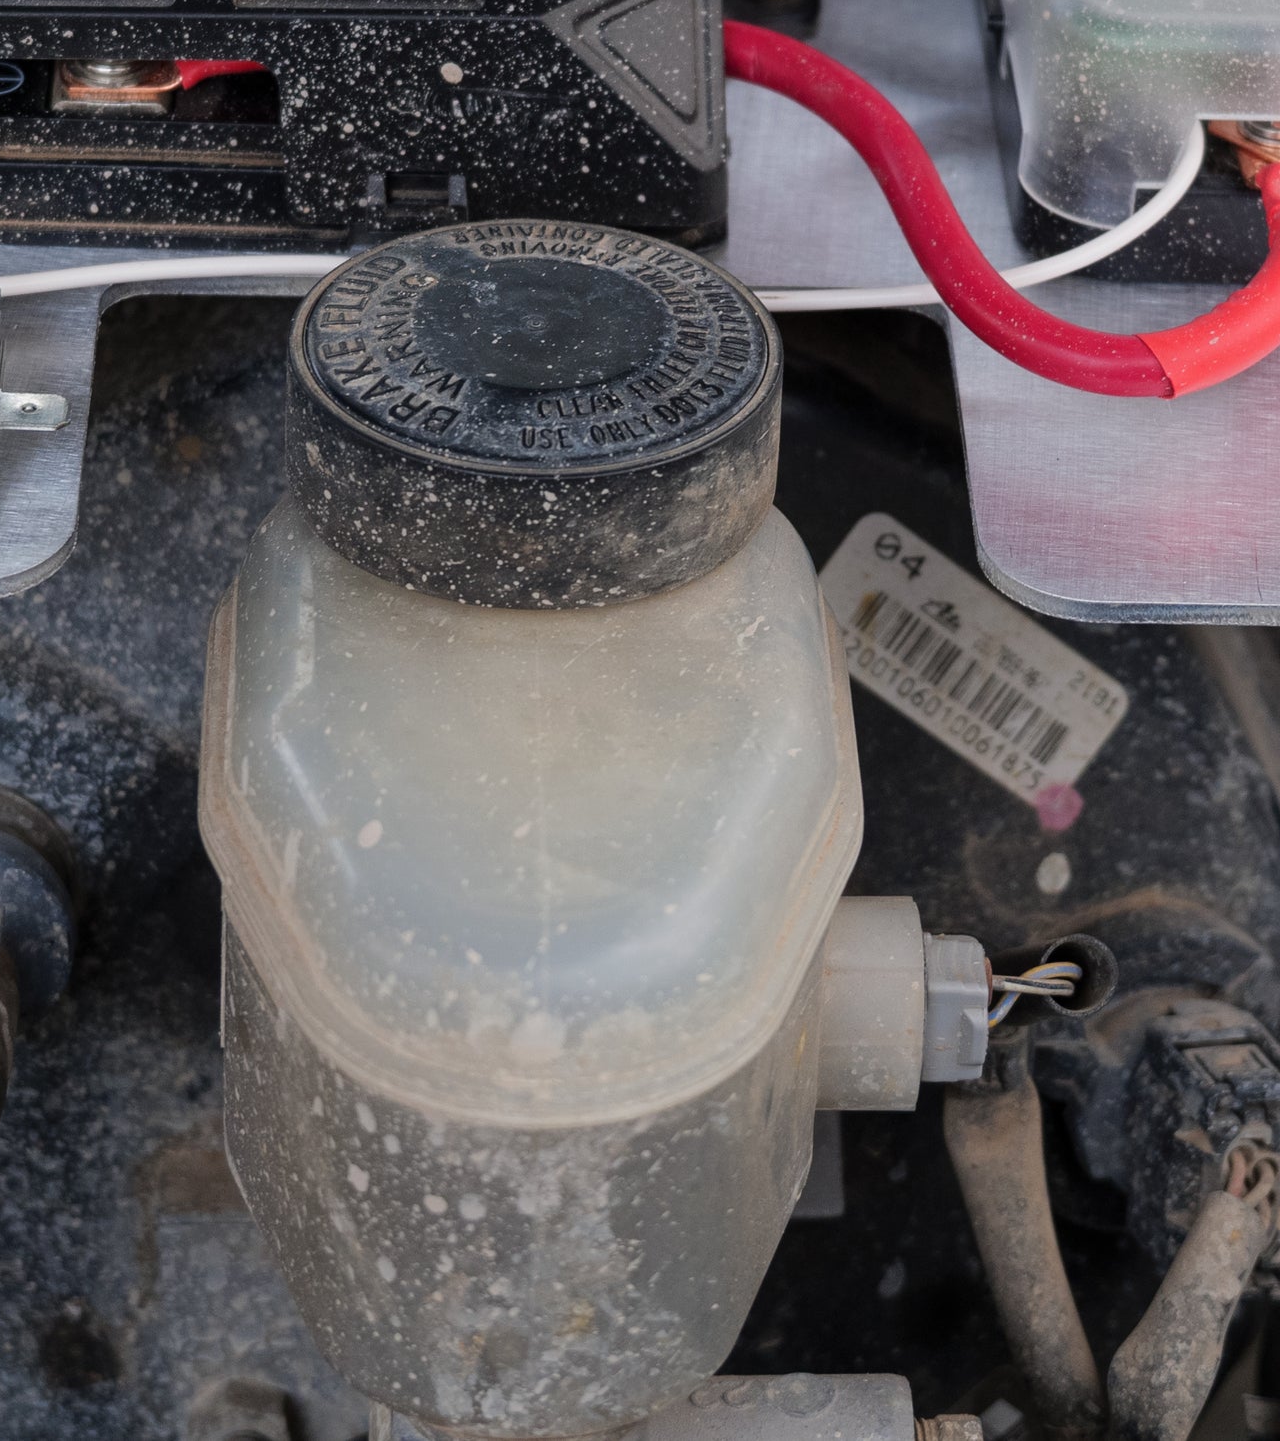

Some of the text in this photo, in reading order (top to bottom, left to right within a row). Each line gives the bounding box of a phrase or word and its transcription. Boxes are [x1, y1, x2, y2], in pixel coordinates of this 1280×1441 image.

[453, 225, 604, 245] CONTAINER
[615, 237, 708, 280] SEALED
[374, 272, 467, 400] WARNING
[479, 240, 709, 419] CLEAN FILLER CAP BEFORE REMOVING
[704, 291, 750, 336] FROM
[320, 256, 461, 435] BRAKE FLUID
[711, 336, 751, 384] FLUID
[654, 379, 724, 424] DOT3
[520, 426, 573, 449] USE
[589, 413, 656, 446] ONLY
